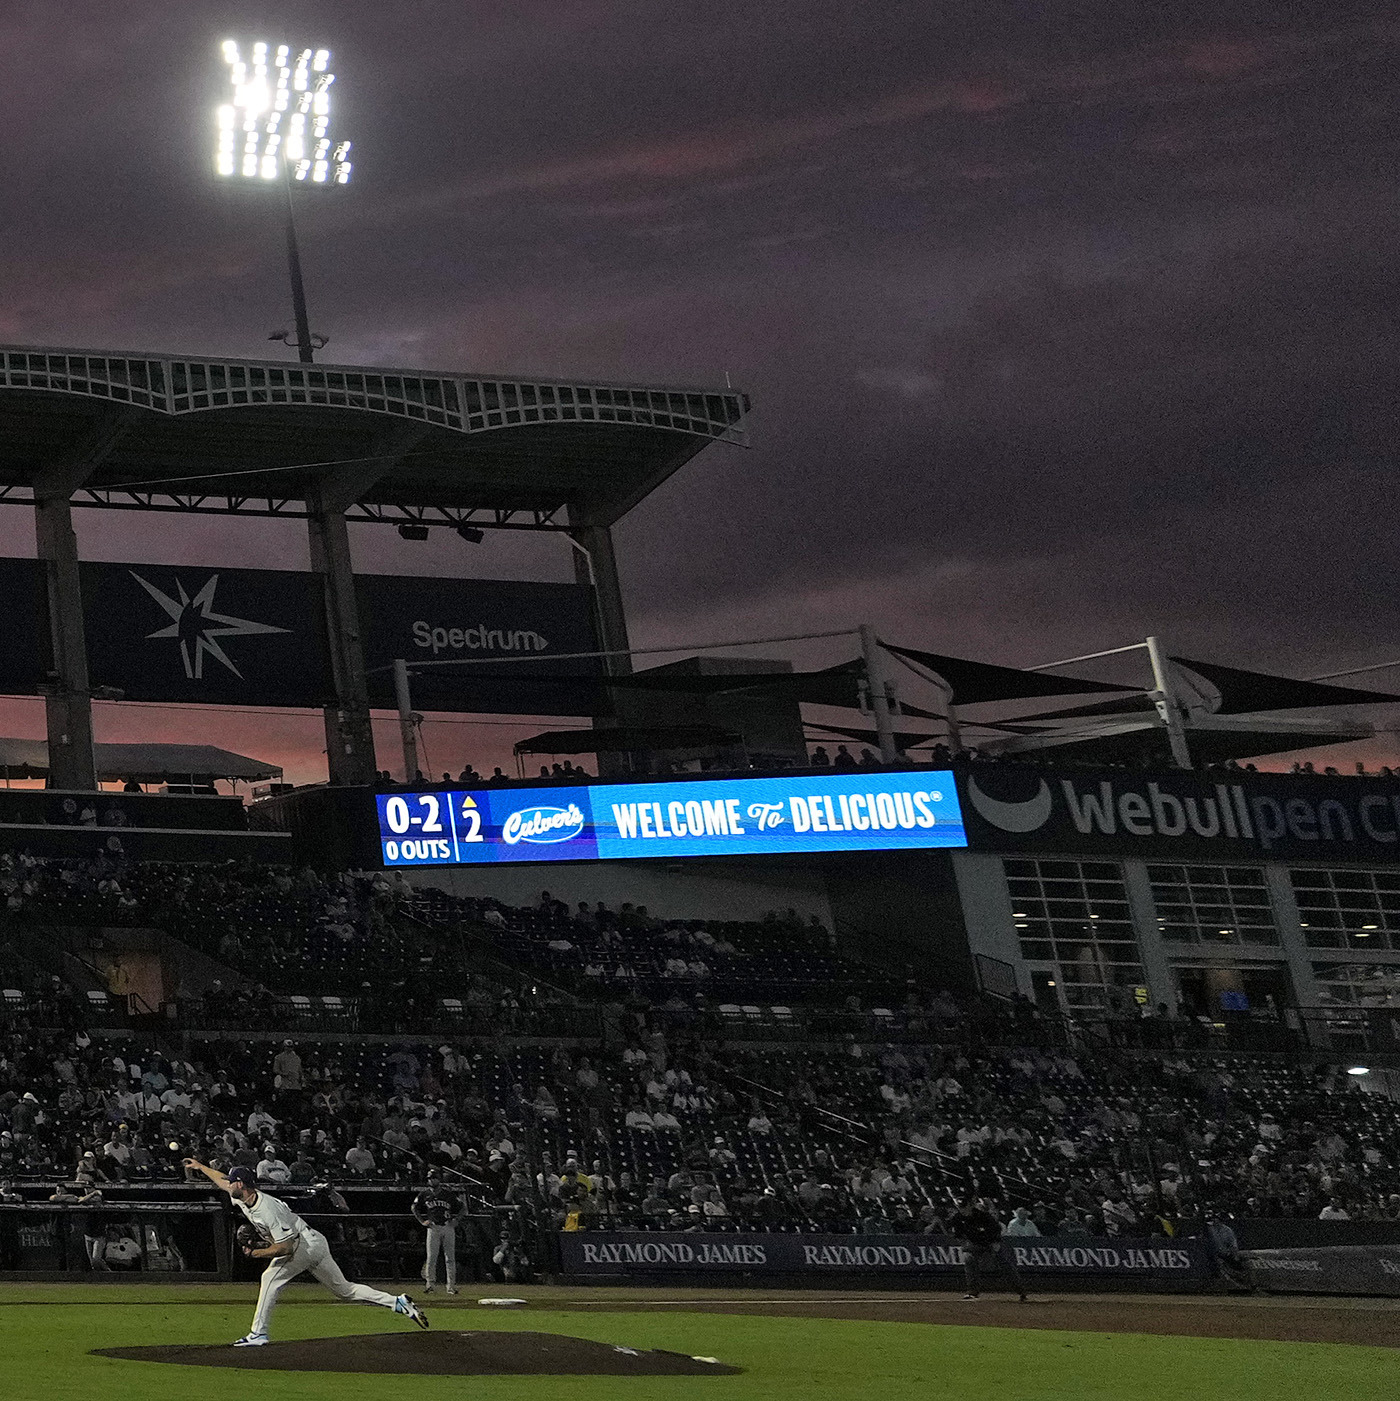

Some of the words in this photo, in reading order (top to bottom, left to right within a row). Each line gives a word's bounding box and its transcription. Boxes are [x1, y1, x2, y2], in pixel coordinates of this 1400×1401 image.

[412, 620, 542, 654] Spectrum
[386, 795, 443, 834] 0-2
[462, 809, 484, 843] 2
[502, 803, 584, 844] Culver's
[612, 799, 746, 839] WELCOME
[747, 801, 785, 832] To
[386, 841, 399, 861] 0
[401, 839, 451, 860] OUTS
[582, 1243, 694, 1264] RAYMOND
[696, 1243, 767, 1265] JAMES
[802, 1244, 912, 1267] RAYMOND
[914, 1246, 967, 1267] JAM
[1013, 1247, 1123, 1268] RAYMOND
[1123, 1248, 1191, 1270] JAMES
